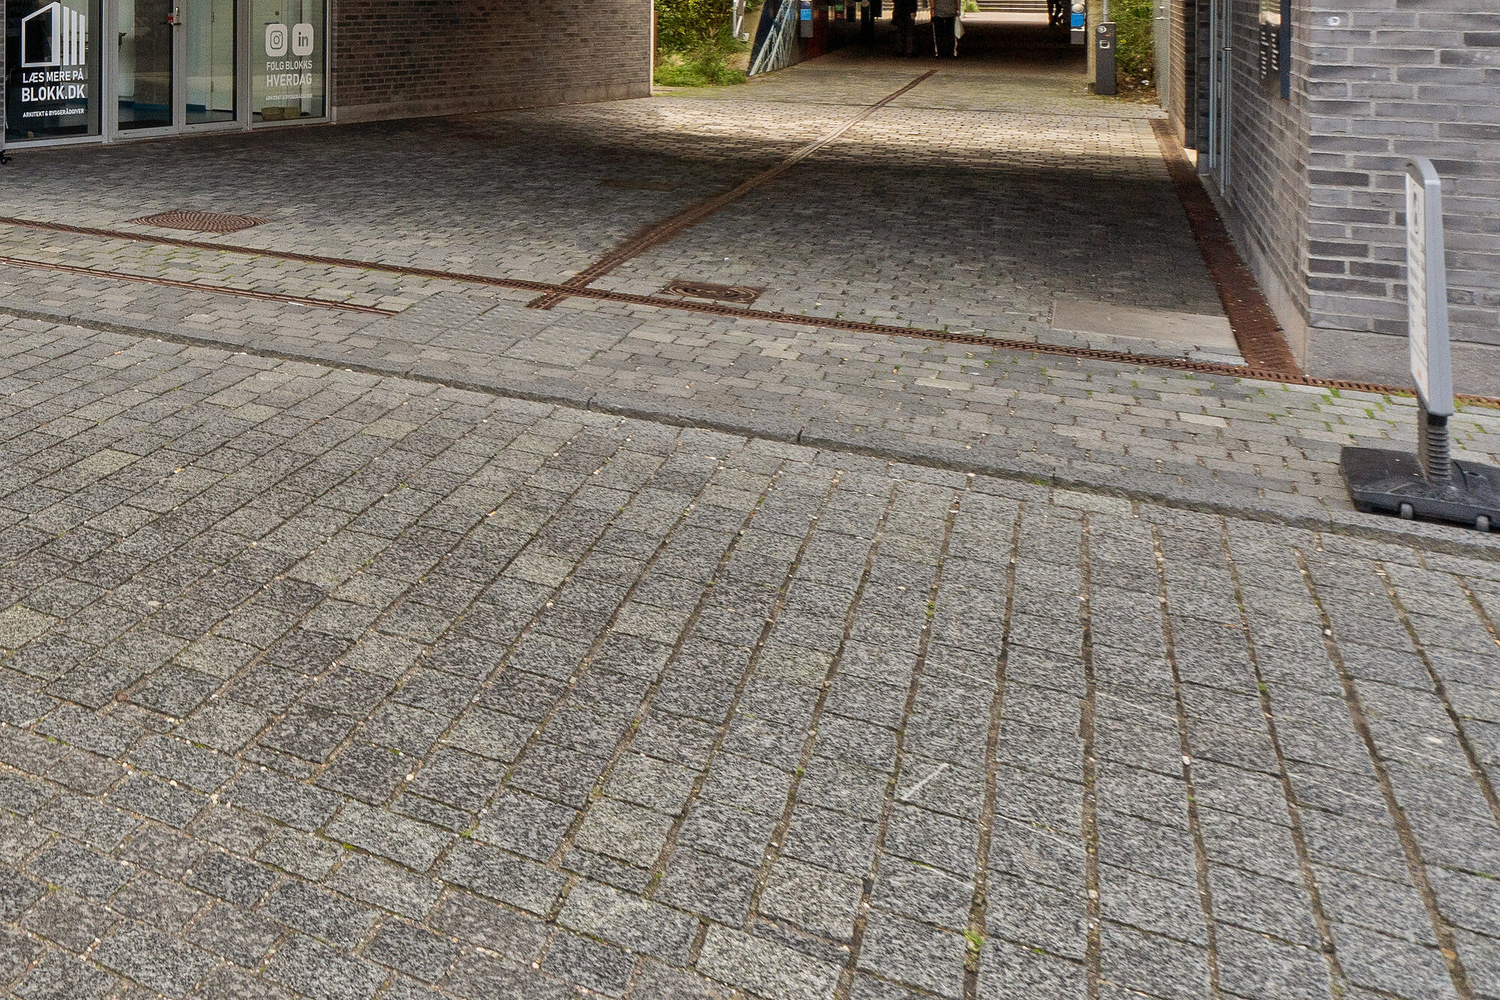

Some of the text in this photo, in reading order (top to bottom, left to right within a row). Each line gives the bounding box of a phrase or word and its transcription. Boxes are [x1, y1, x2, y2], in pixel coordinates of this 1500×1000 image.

[298, 31, 309, 47] in
[285, 60, 312, 69] BLOKKS
[22, 68, 84, 83] LÆS MERE PÅ
[266, 73, 312, 87] HVERDAG
[21, 85, 86, 102] BLOKK.DK
